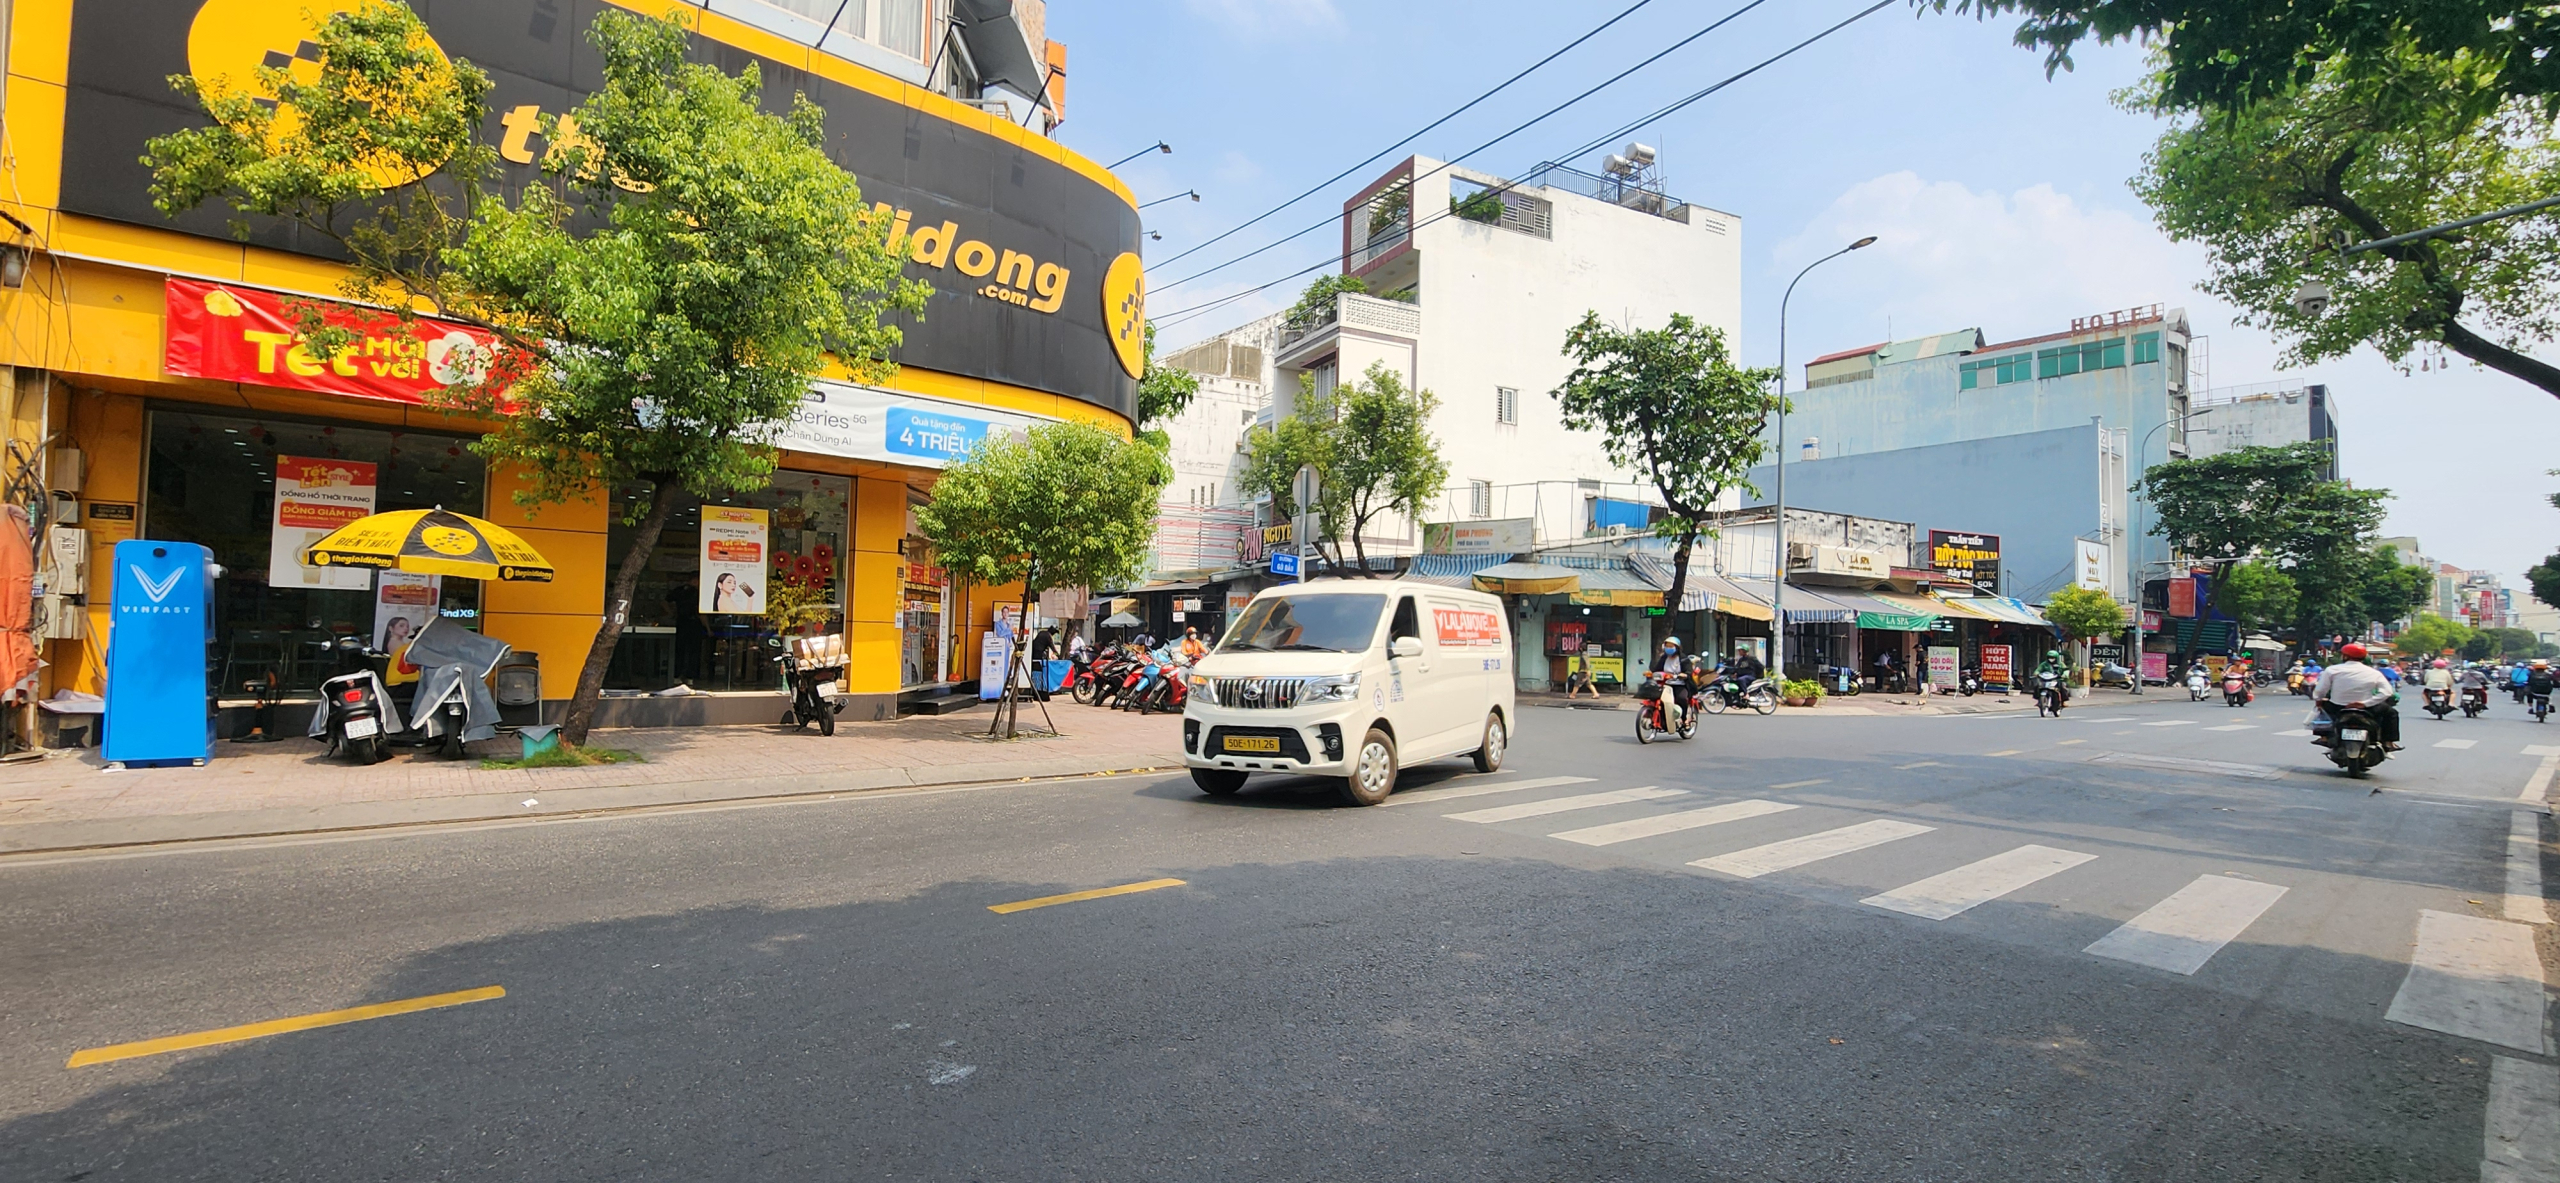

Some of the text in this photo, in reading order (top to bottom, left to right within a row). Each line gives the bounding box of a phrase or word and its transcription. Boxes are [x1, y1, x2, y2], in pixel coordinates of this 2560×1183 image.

[977, 285, 1027, 306] .com
[790, 405, 867, 429] Series 5G
[911, 415, 966, 432] Quà tặng đến
[814, 432, 840, 447] Dung
[841, 437, 851, 446] AI
[900, 427, 972, 456] 4 TRIỆU
[343, 495, 371, 503] TRANG
[318, 506, 345, 517] GIẢM
[1455, 528, 1470, 539] QUÁN
[332, 555, 393, 567] thegioididong
[1860, 556, 1870, 565] SPA
[1956, 545, 1976, 569] TÓC
[1985, 569, 1997, 579] TÓC
[121, 605, 191, 614] VINFAST
[460, 609, 475, 618] X9
[1443, 610, 1489, 631] LALAMOVE
[1897, 617, 1909, 626] SPA
[2093, 646, 2120, 656] ĐÈN
